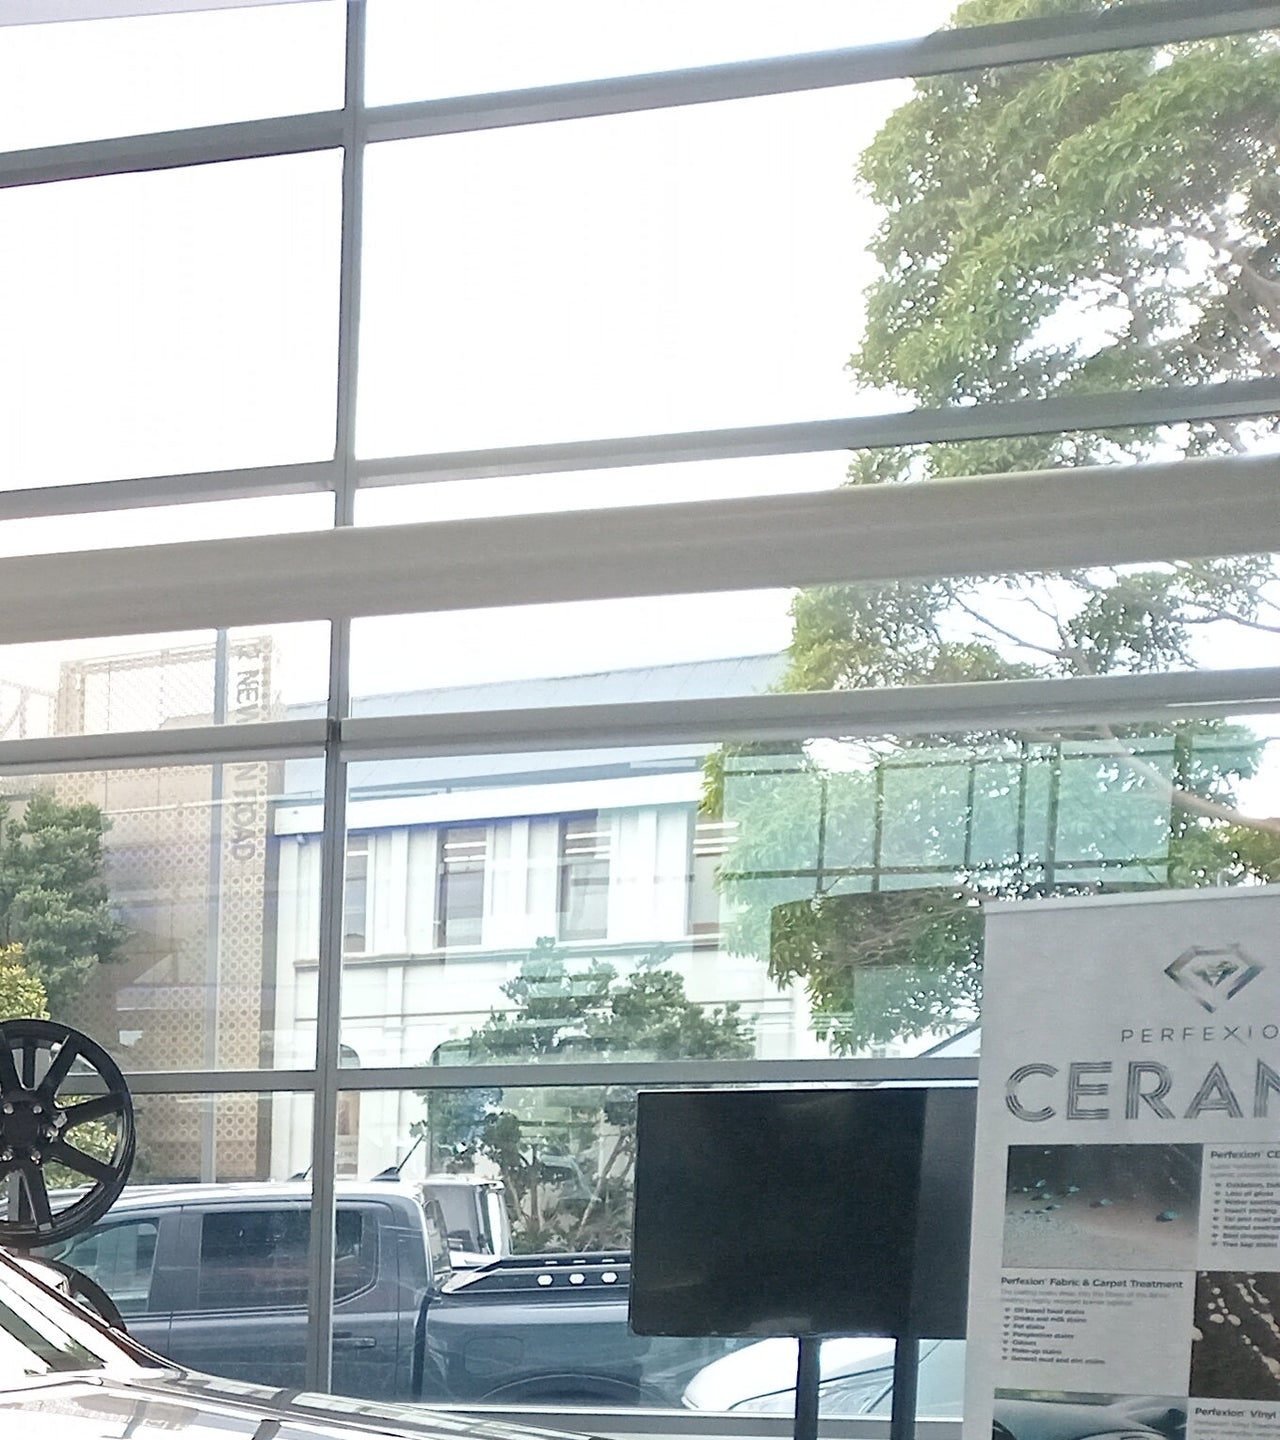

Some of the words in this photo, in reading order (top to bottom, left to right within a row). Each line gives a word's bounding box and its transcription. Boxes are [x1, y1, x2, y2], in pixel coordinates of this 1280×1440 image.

[1050, 1278, 1080, 1287] Fabric
[1093, 1279, 1127, 1288] Carpet
[1130, 1280, 1183, 1288] Treatment
[1250, 1410, 1276, 1420] Vinyl
